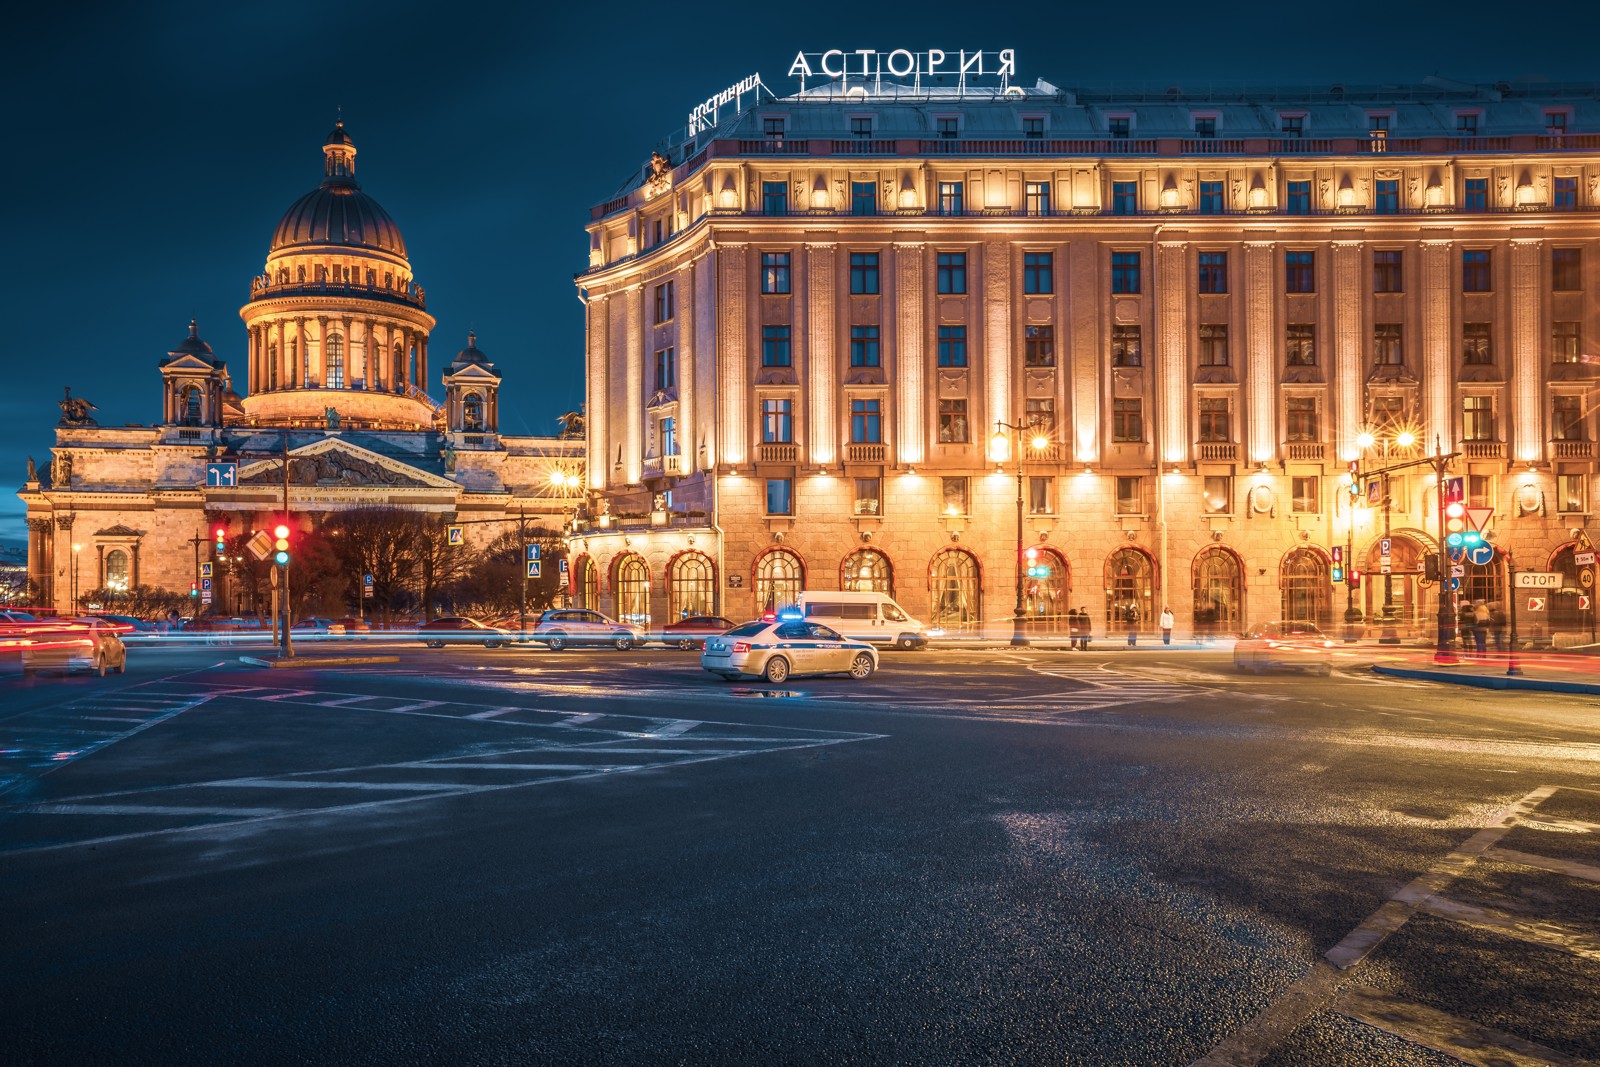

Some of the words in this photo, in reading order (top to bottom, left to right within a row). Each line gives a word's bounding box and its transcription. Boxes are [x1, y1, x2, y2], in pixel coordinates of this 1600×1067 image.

[787, 48, 1015, 77] АСТОРИЯ
[693, 71, 761, 122] ГОСТИНИЦА
[1382, 541, 1389, 554] P
[204, 579, 210, 589] P
[1522, 575, 1556, 585] СТОП
[1582, 574, 1591, 584] 40
